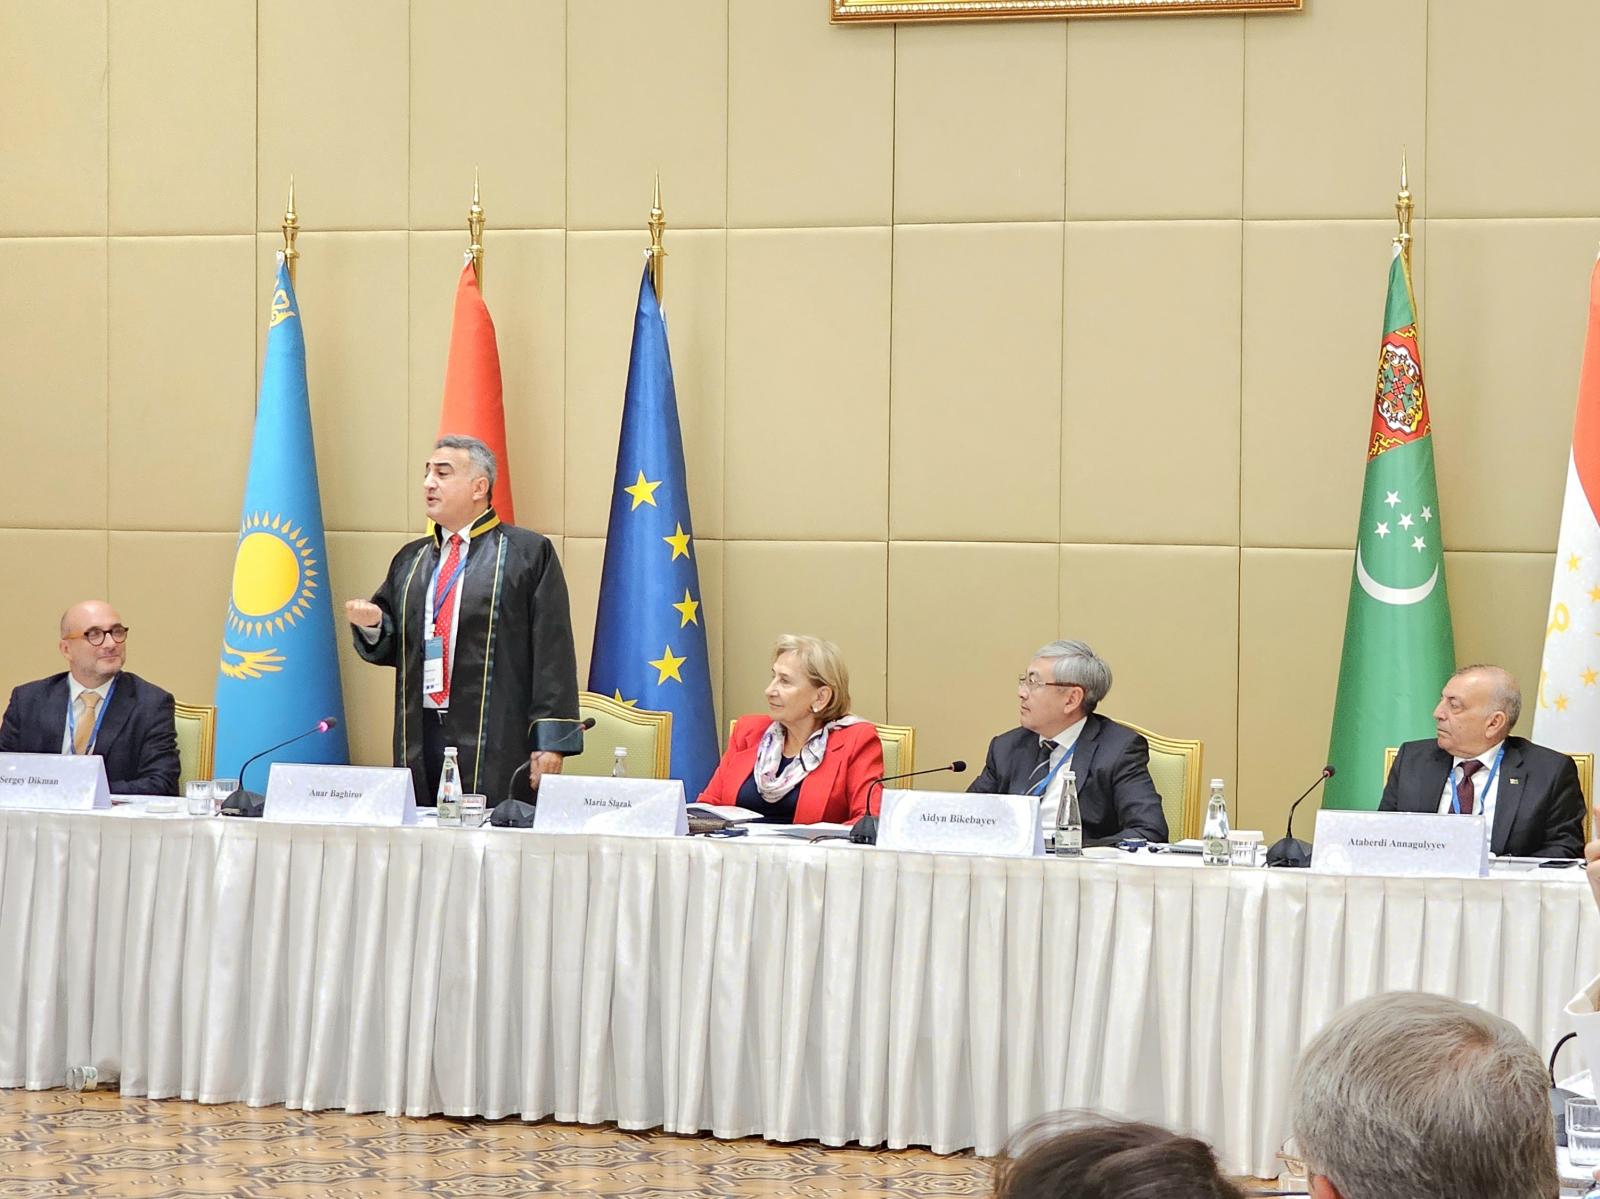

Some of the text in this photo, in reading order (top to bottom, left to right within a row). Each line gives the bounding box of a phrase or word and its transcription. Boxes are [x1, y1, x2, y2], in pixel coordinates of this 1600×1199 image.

[0, 775, 59, 785] Sergey Dikman
[330, 789, 363, 799] Baghirov
[584, 798, 606, 807] Maria
[920, 813, 997, 827] Aidyn Bikebayev
[1348, 838, 1447, 851] Ataberdi Annagulyyev
